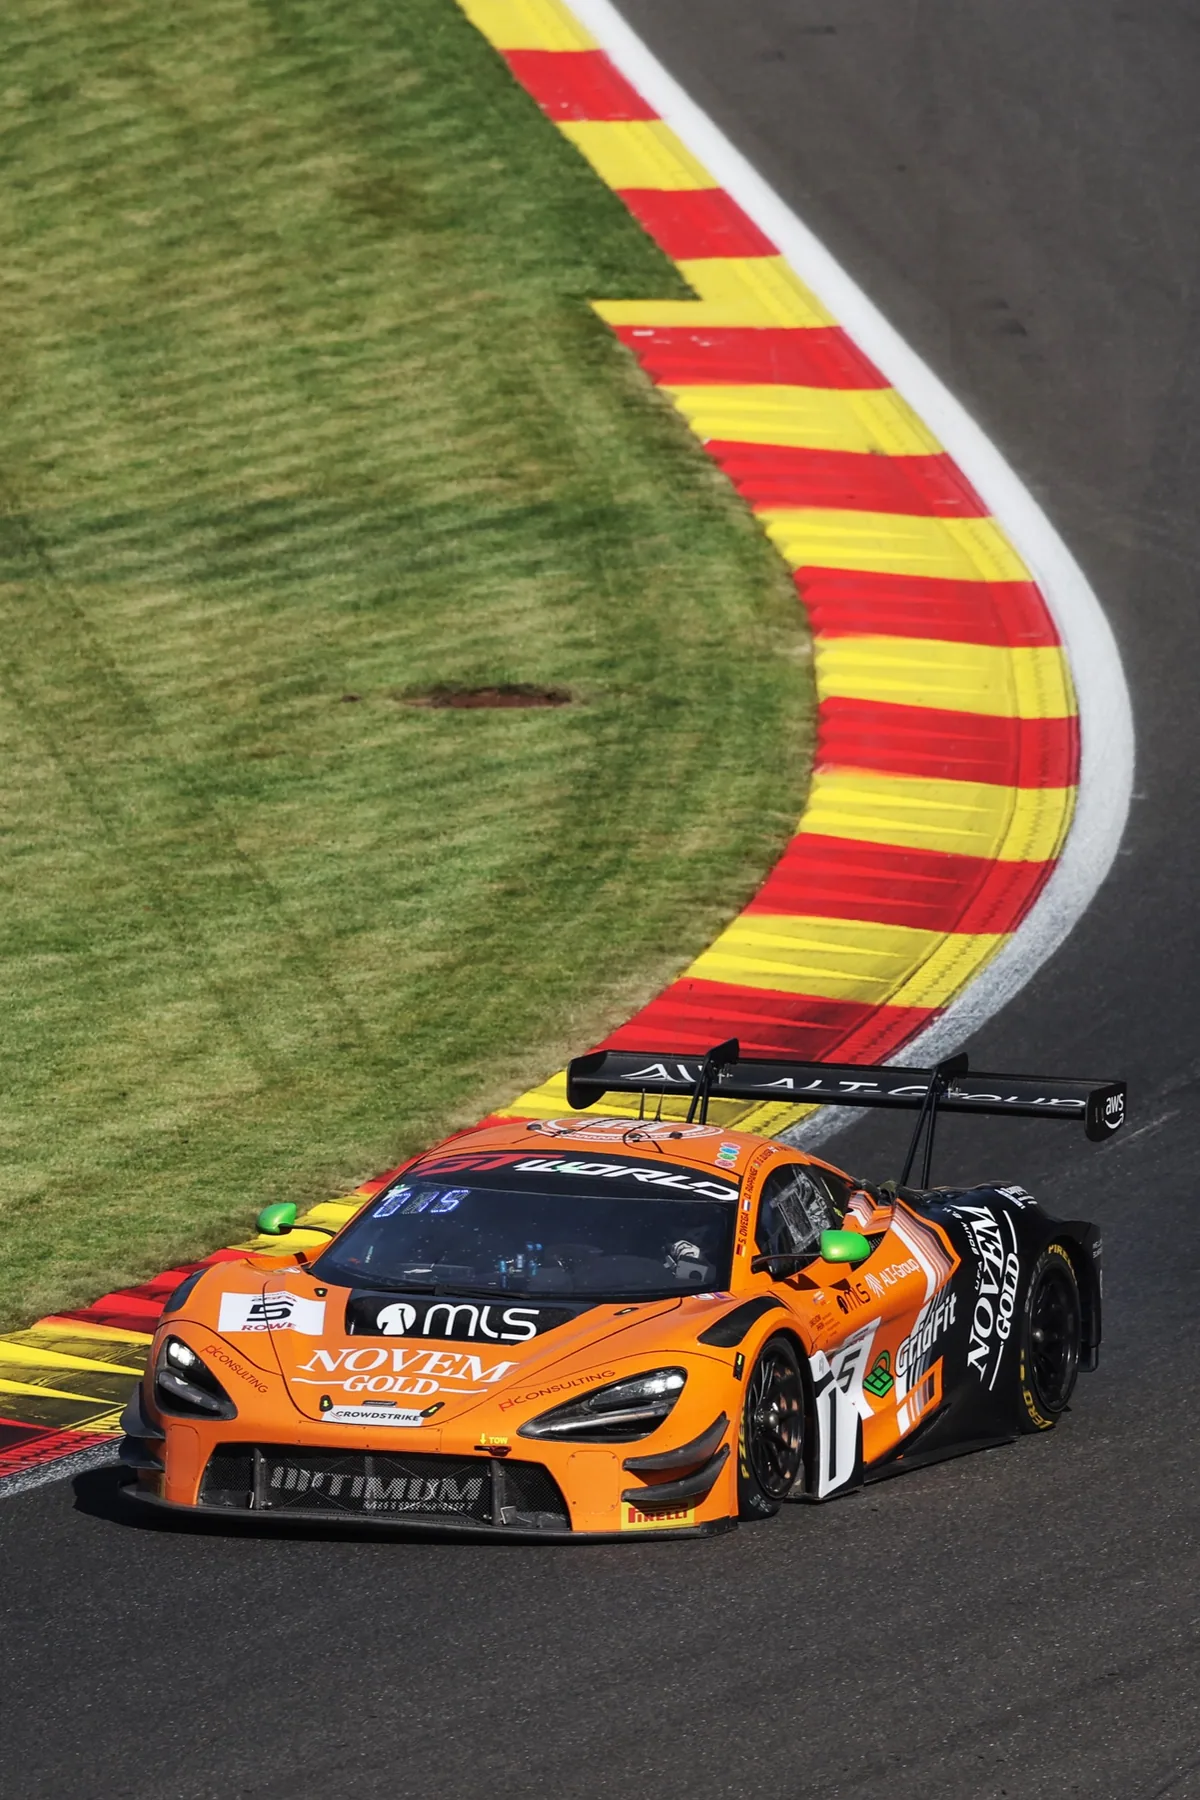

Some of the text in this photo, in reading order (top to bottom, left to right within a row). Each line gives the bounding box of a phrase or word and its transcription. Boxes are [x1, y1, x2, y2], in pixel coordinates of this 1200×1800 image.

[1105, 1093, 1124, 1116] aws
[950, 1204, 1004, 1382] NOVEM
[995, 1252, 1020, 1341] GOLD
[241, 1321, 298, 1331] ROWE
[895, 1292, 957, 1377] GridFit
[296, 1346, 522, 1384] NOVEM
[342, 1374, 440, 1396] GOLD
[335, 1410, 420, 1422] CROWDSTRIKE
[489, 1436, 508, 1445] TOW
